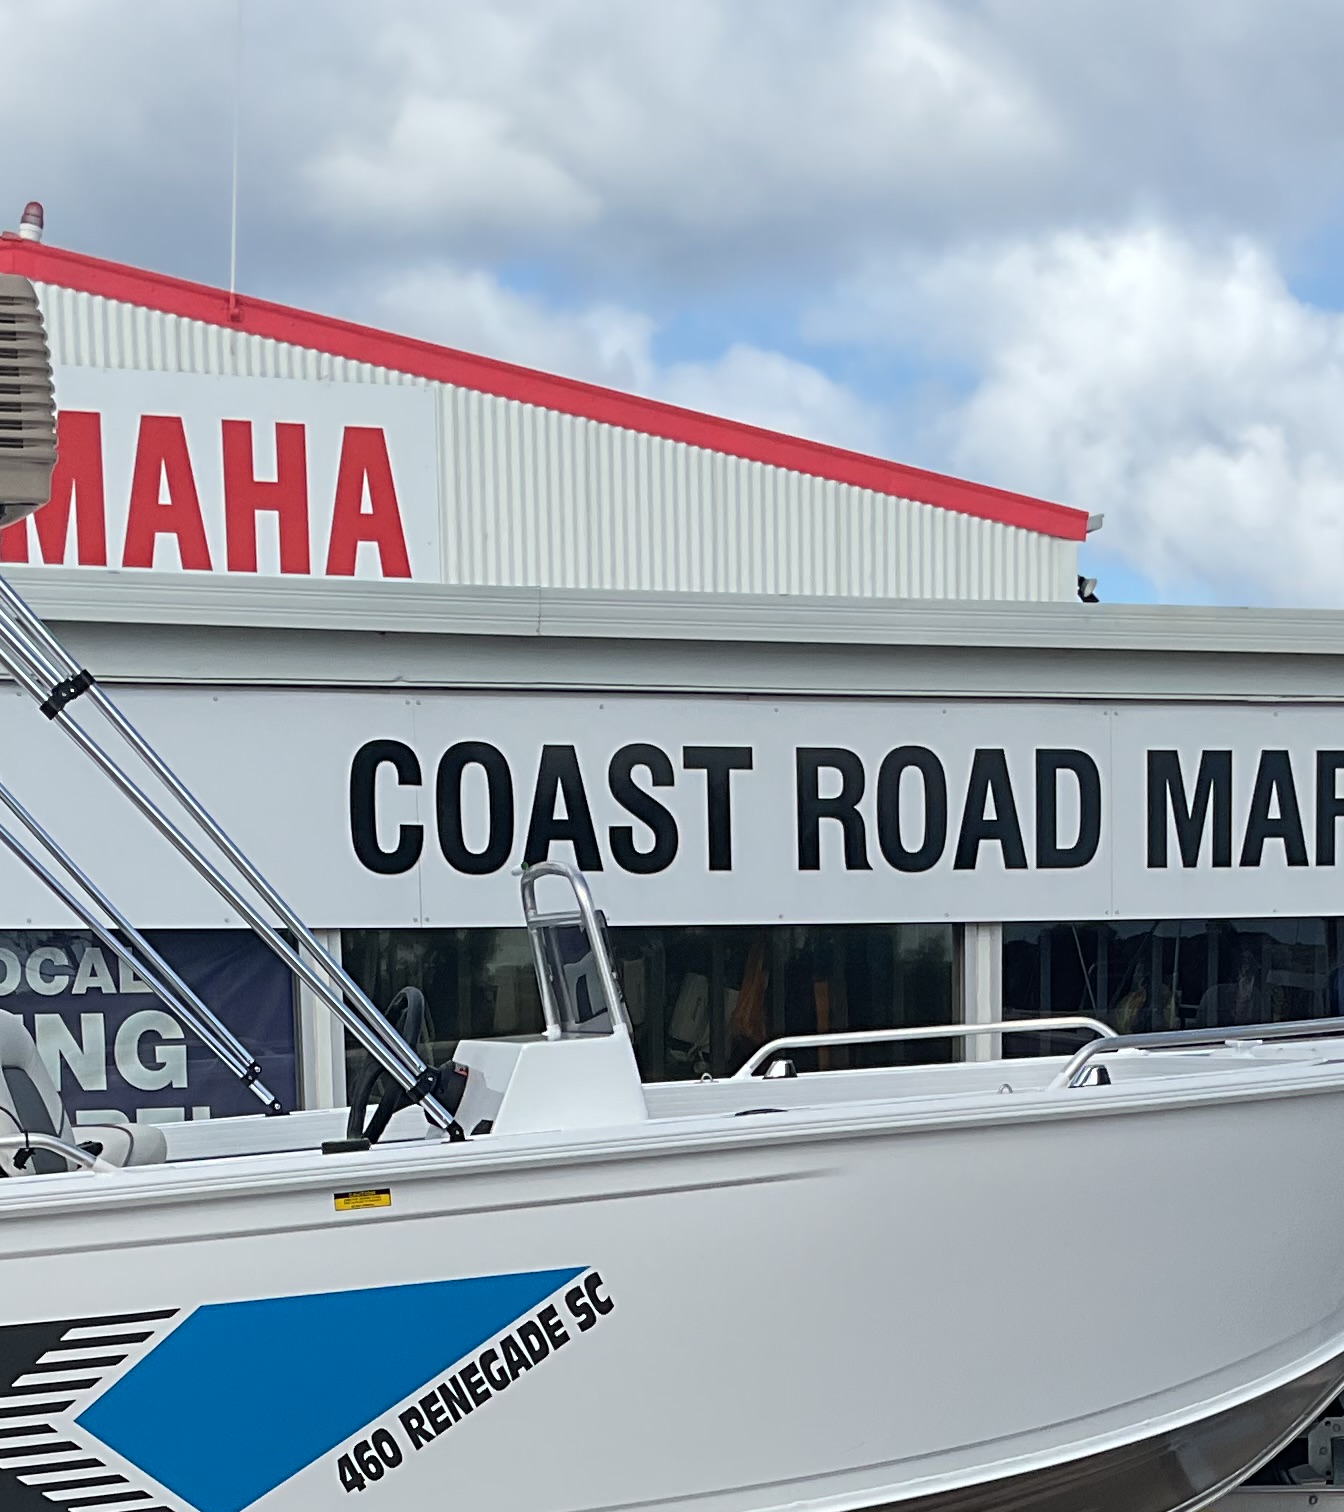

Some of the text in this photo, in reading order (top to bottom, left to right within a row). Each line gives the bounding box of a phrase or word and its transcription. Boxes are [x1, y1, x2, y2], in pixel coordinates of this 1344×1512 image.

[0, 410, 413, 578] MAHA
[349, 739, 754, 875] COAST
[794, 745, 1102, 873] ROAD
[337, 1271, 615, 1493] 460 RENEGADE SC
